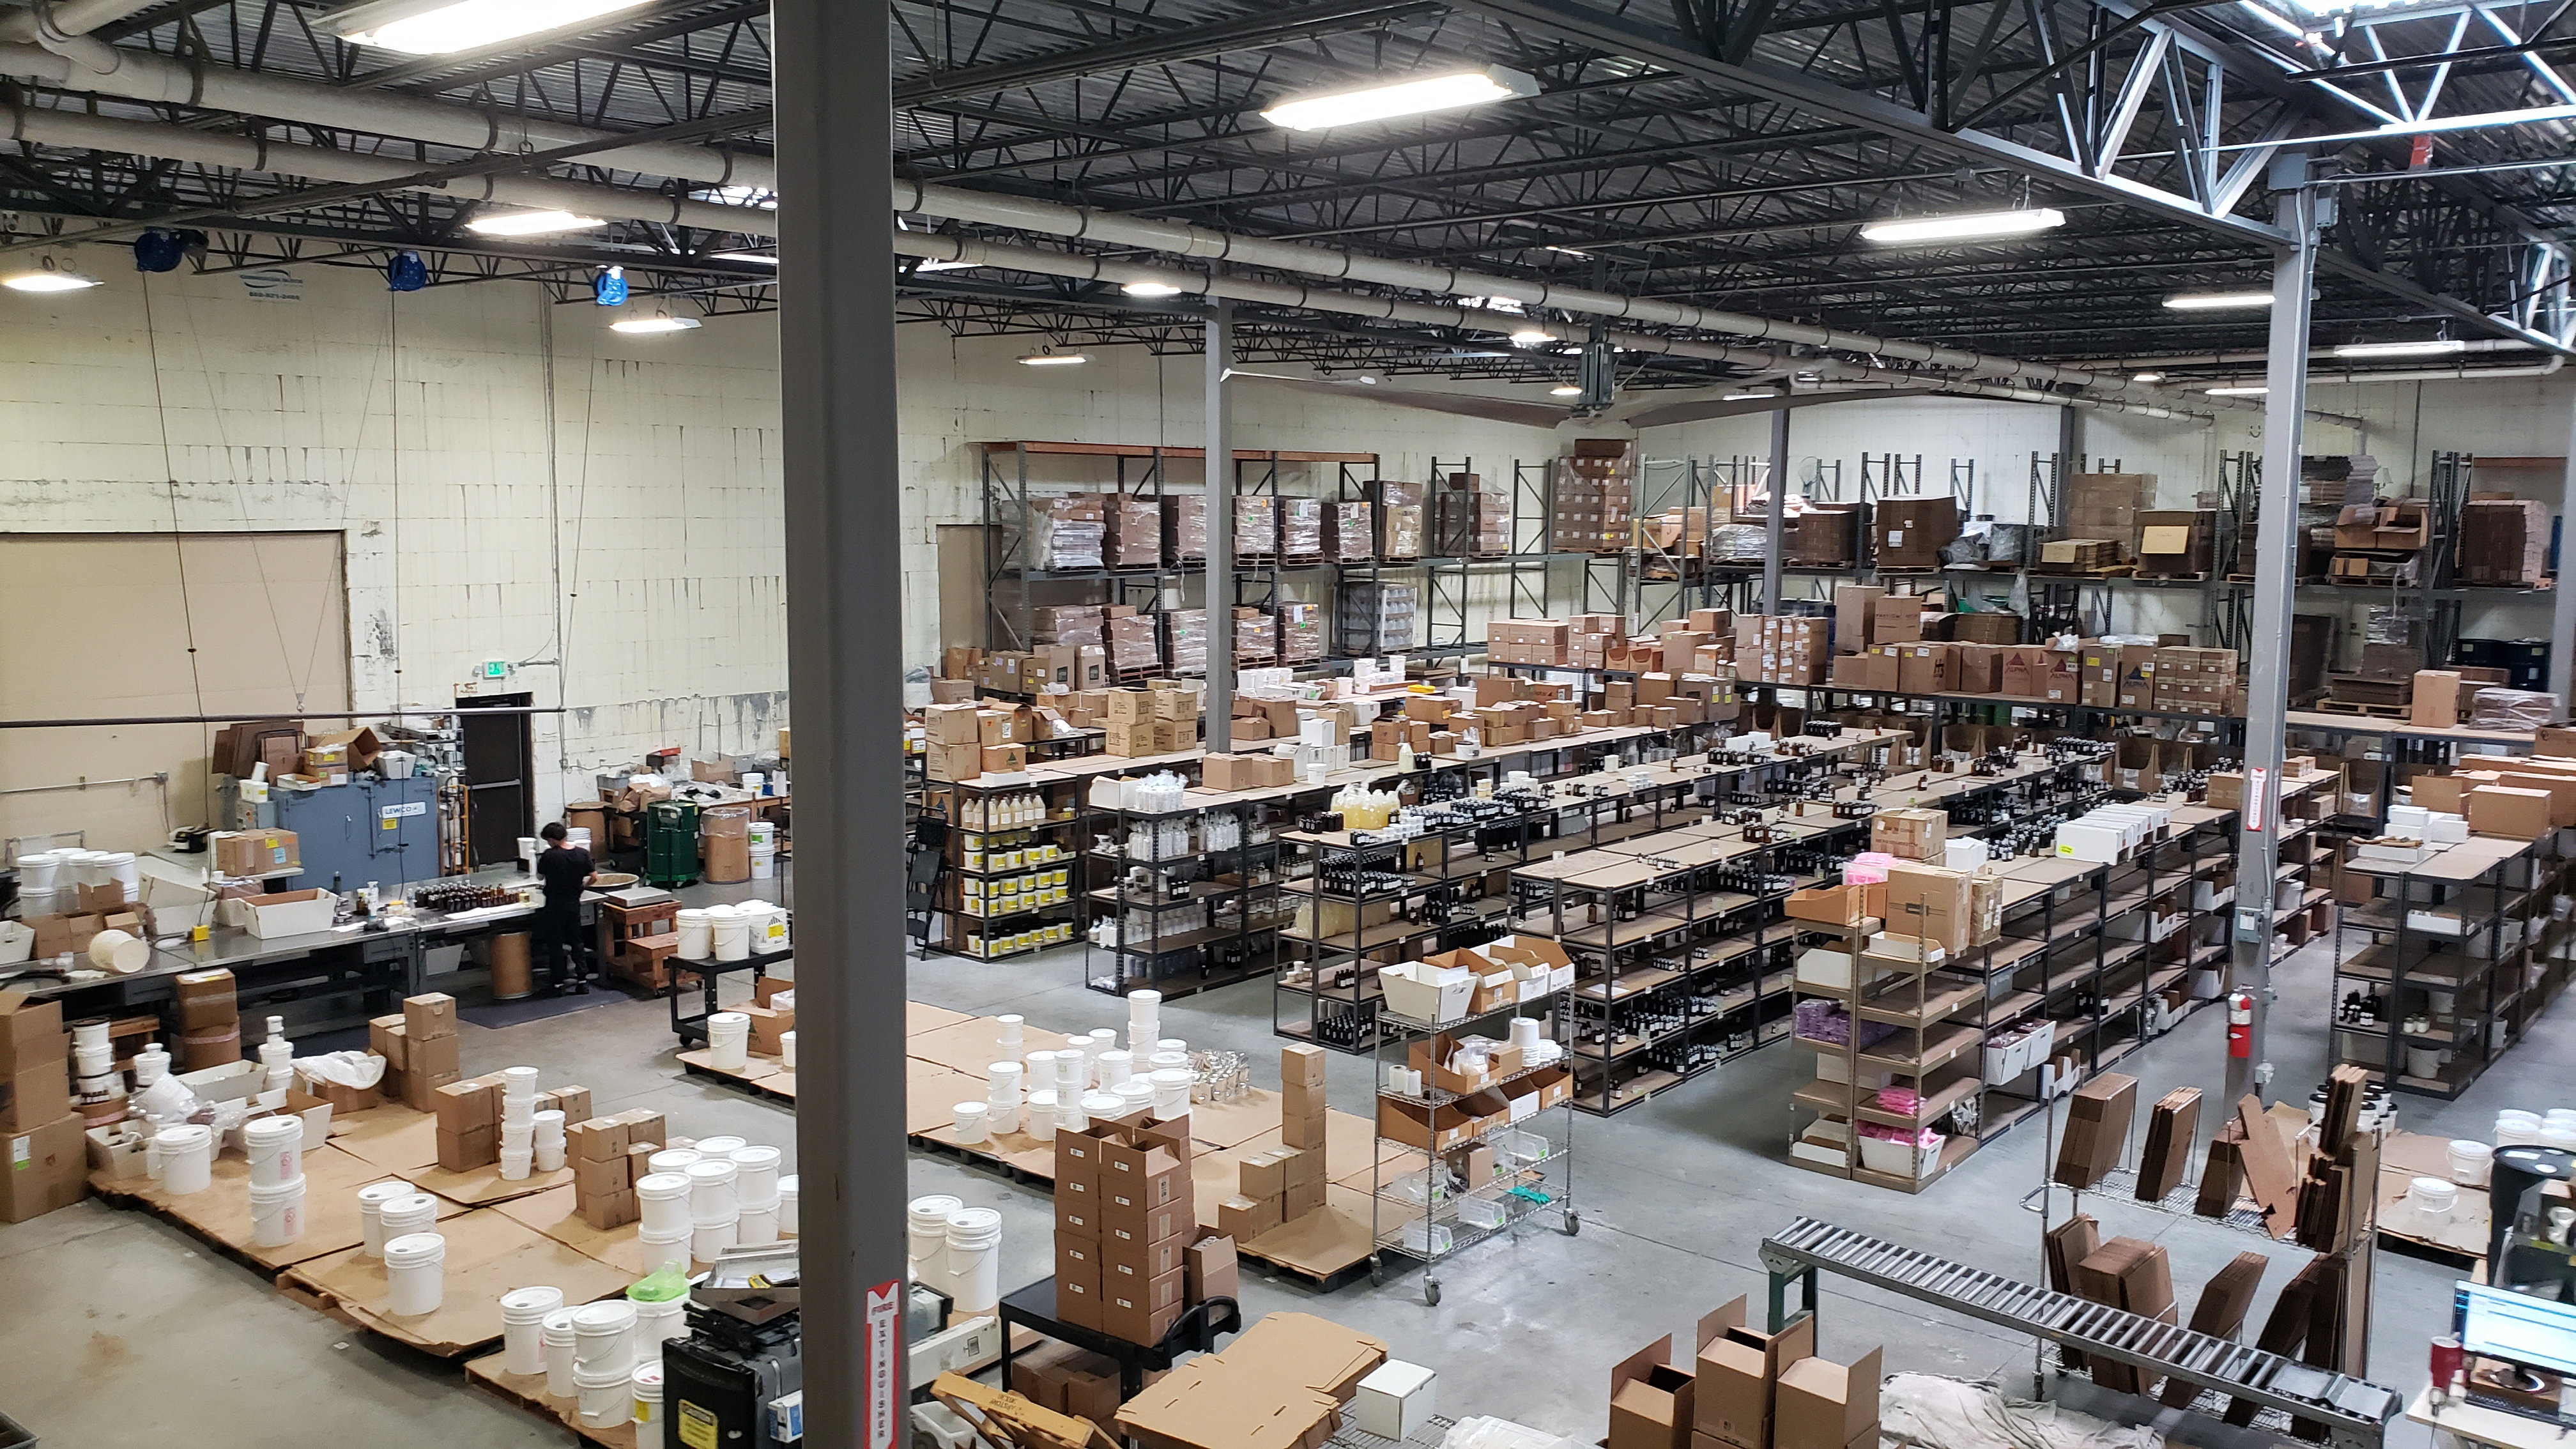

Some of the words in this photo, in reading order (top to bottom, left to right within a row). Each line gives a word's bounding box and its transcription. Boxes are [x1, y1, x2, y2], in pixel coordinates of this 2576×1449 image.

[2005, 666, 2030, 675] ALPHA
[2049, 673, 2074, 682] ALPHA
[871, 1301, 894, 1315] FIRE
[877, 1319, 886, 1438] EXTINGUISHER
